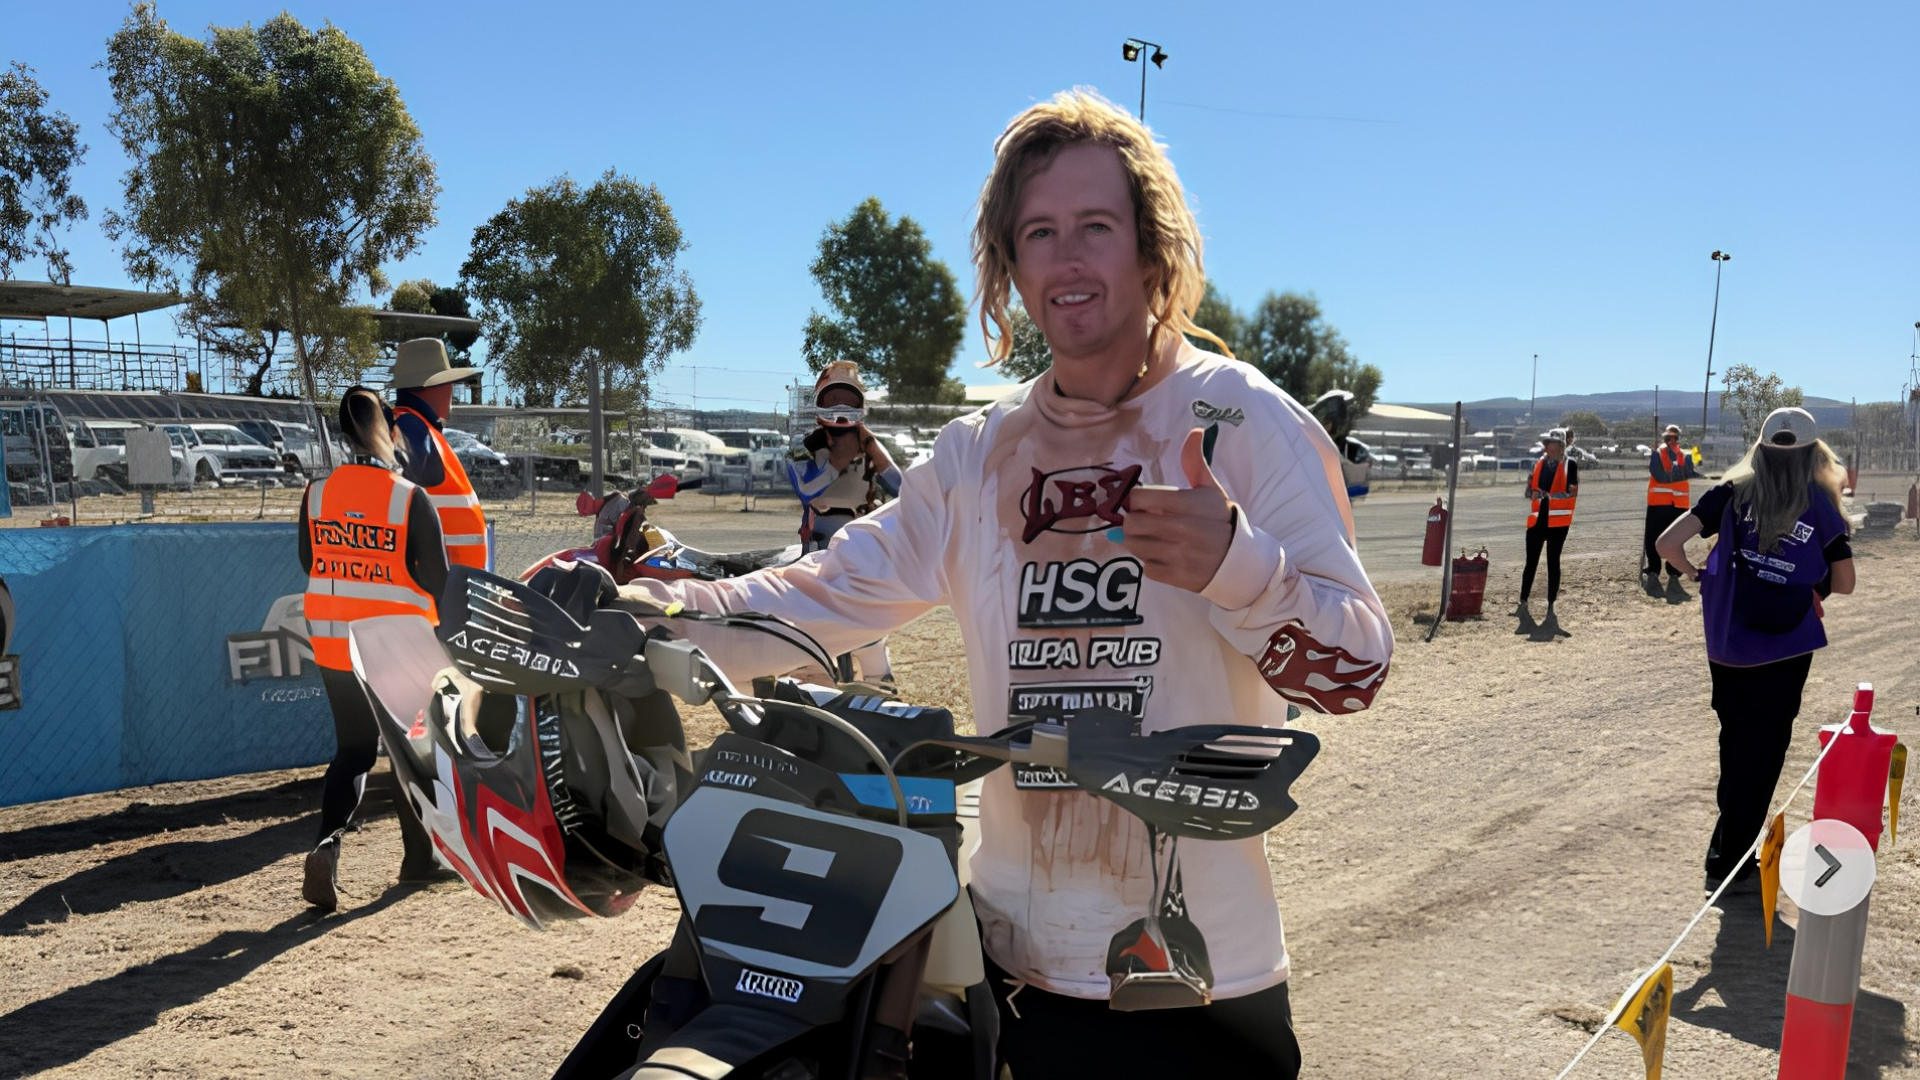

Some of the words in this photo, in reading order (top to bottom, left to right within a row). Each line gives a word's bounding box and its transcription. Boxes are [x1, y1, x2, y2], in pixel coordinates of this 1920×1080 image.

[1019, 558, 1142, 616] HSG
[1088, 637, 1160, 668] PUB
[694, 807, 905, 969] 9
